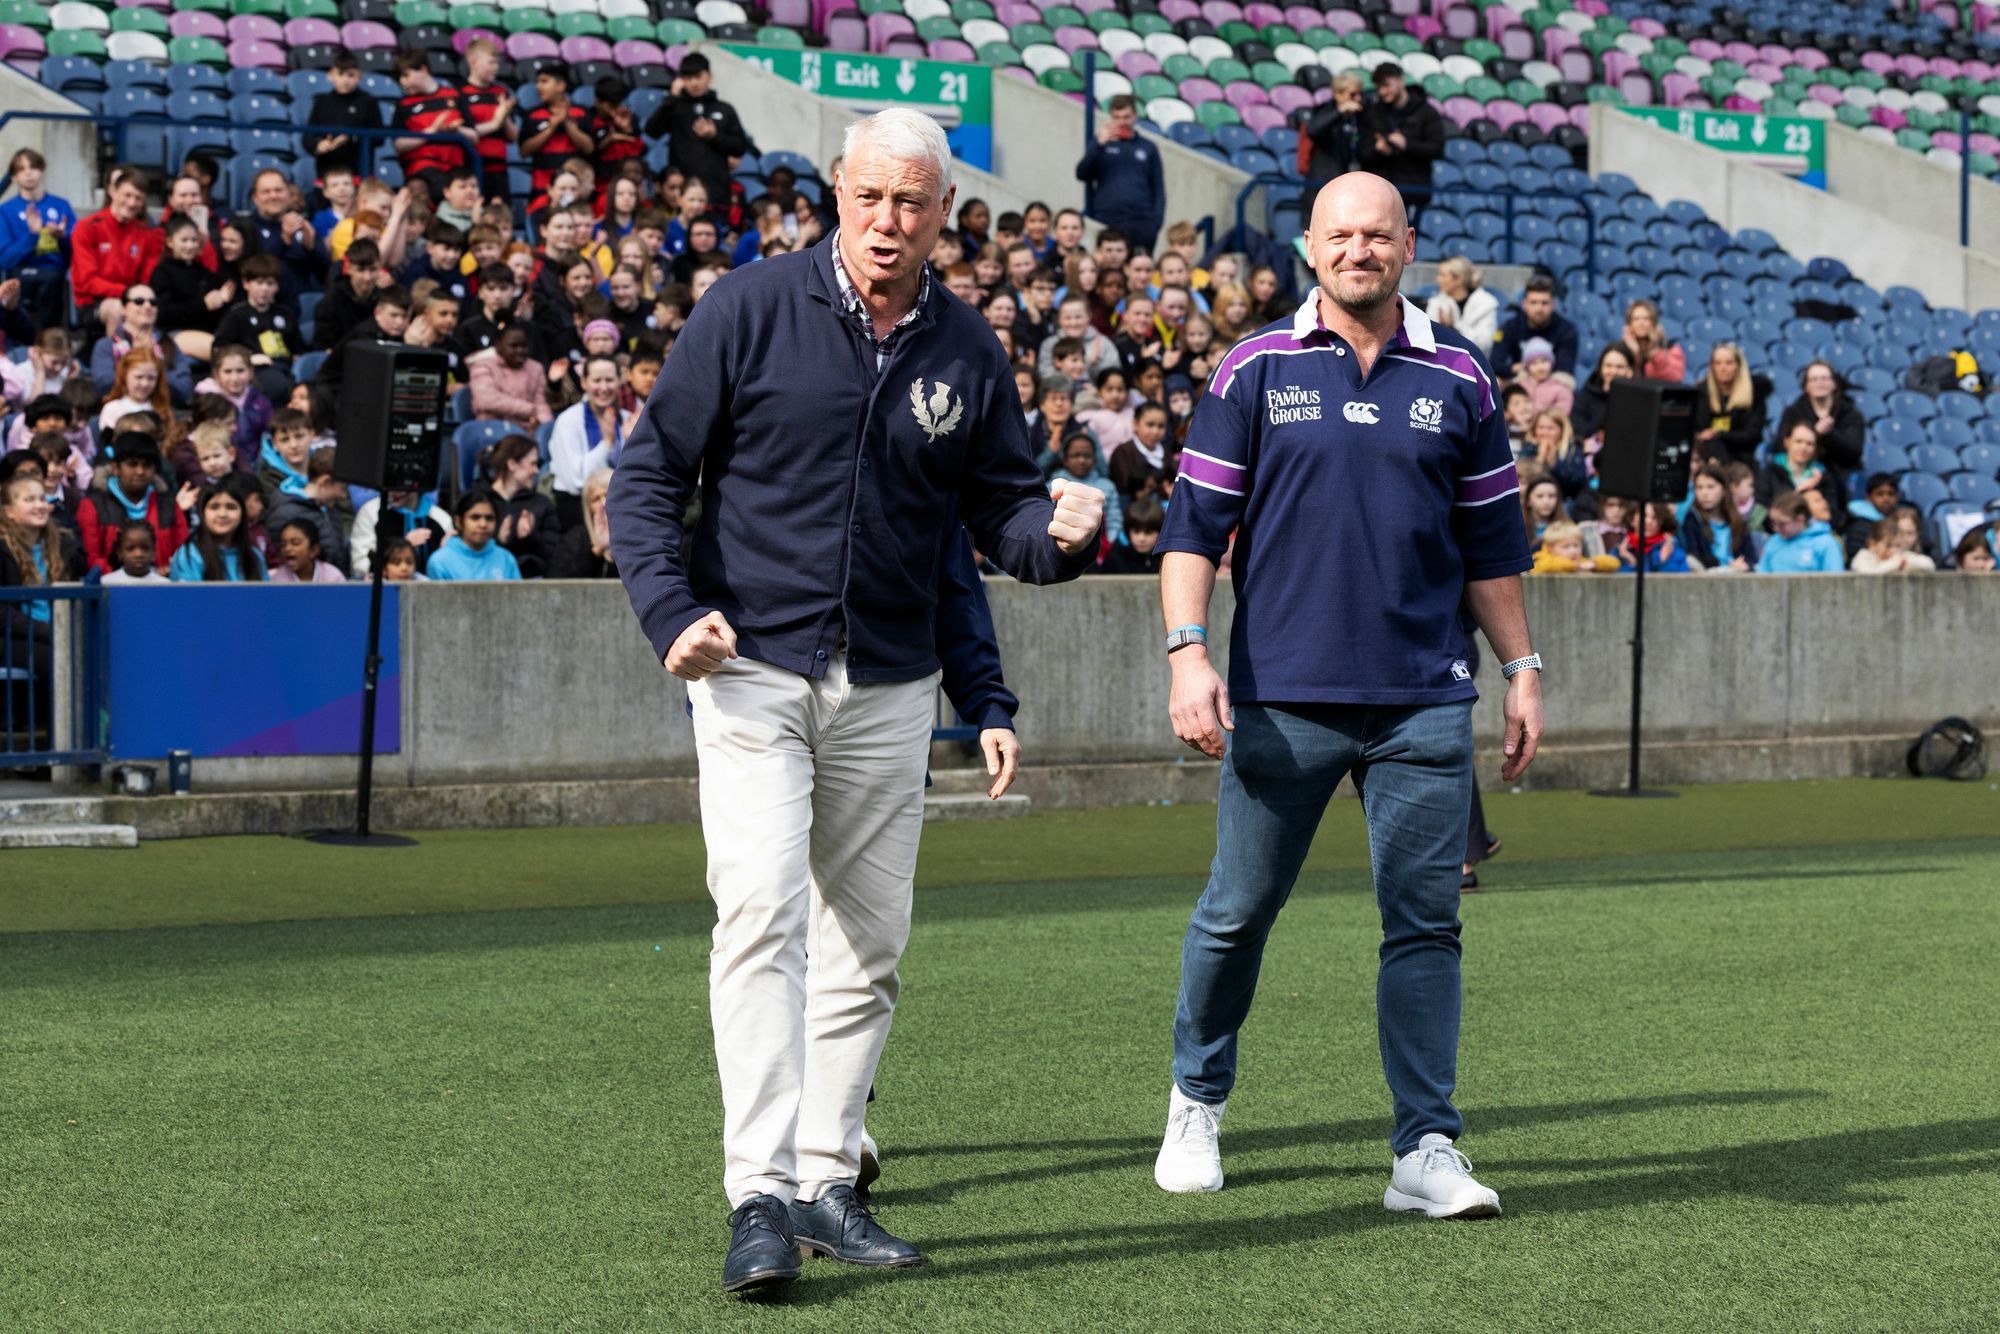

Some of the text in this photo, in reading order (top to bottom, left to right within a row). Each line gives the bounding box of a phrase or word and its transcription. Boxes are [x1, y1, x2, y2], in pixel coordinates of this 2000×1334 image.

[834, 60, 881, 89] Exit
[939, 71, 968, 103] 21
[1704, 117, 1812, 153] Exit 23
[1266, 389, 1321, 409] FAMOUS
[1269, 406, 1322, 425] GROUSE
[1409, 421, 1442, 434] SCOTLAND
